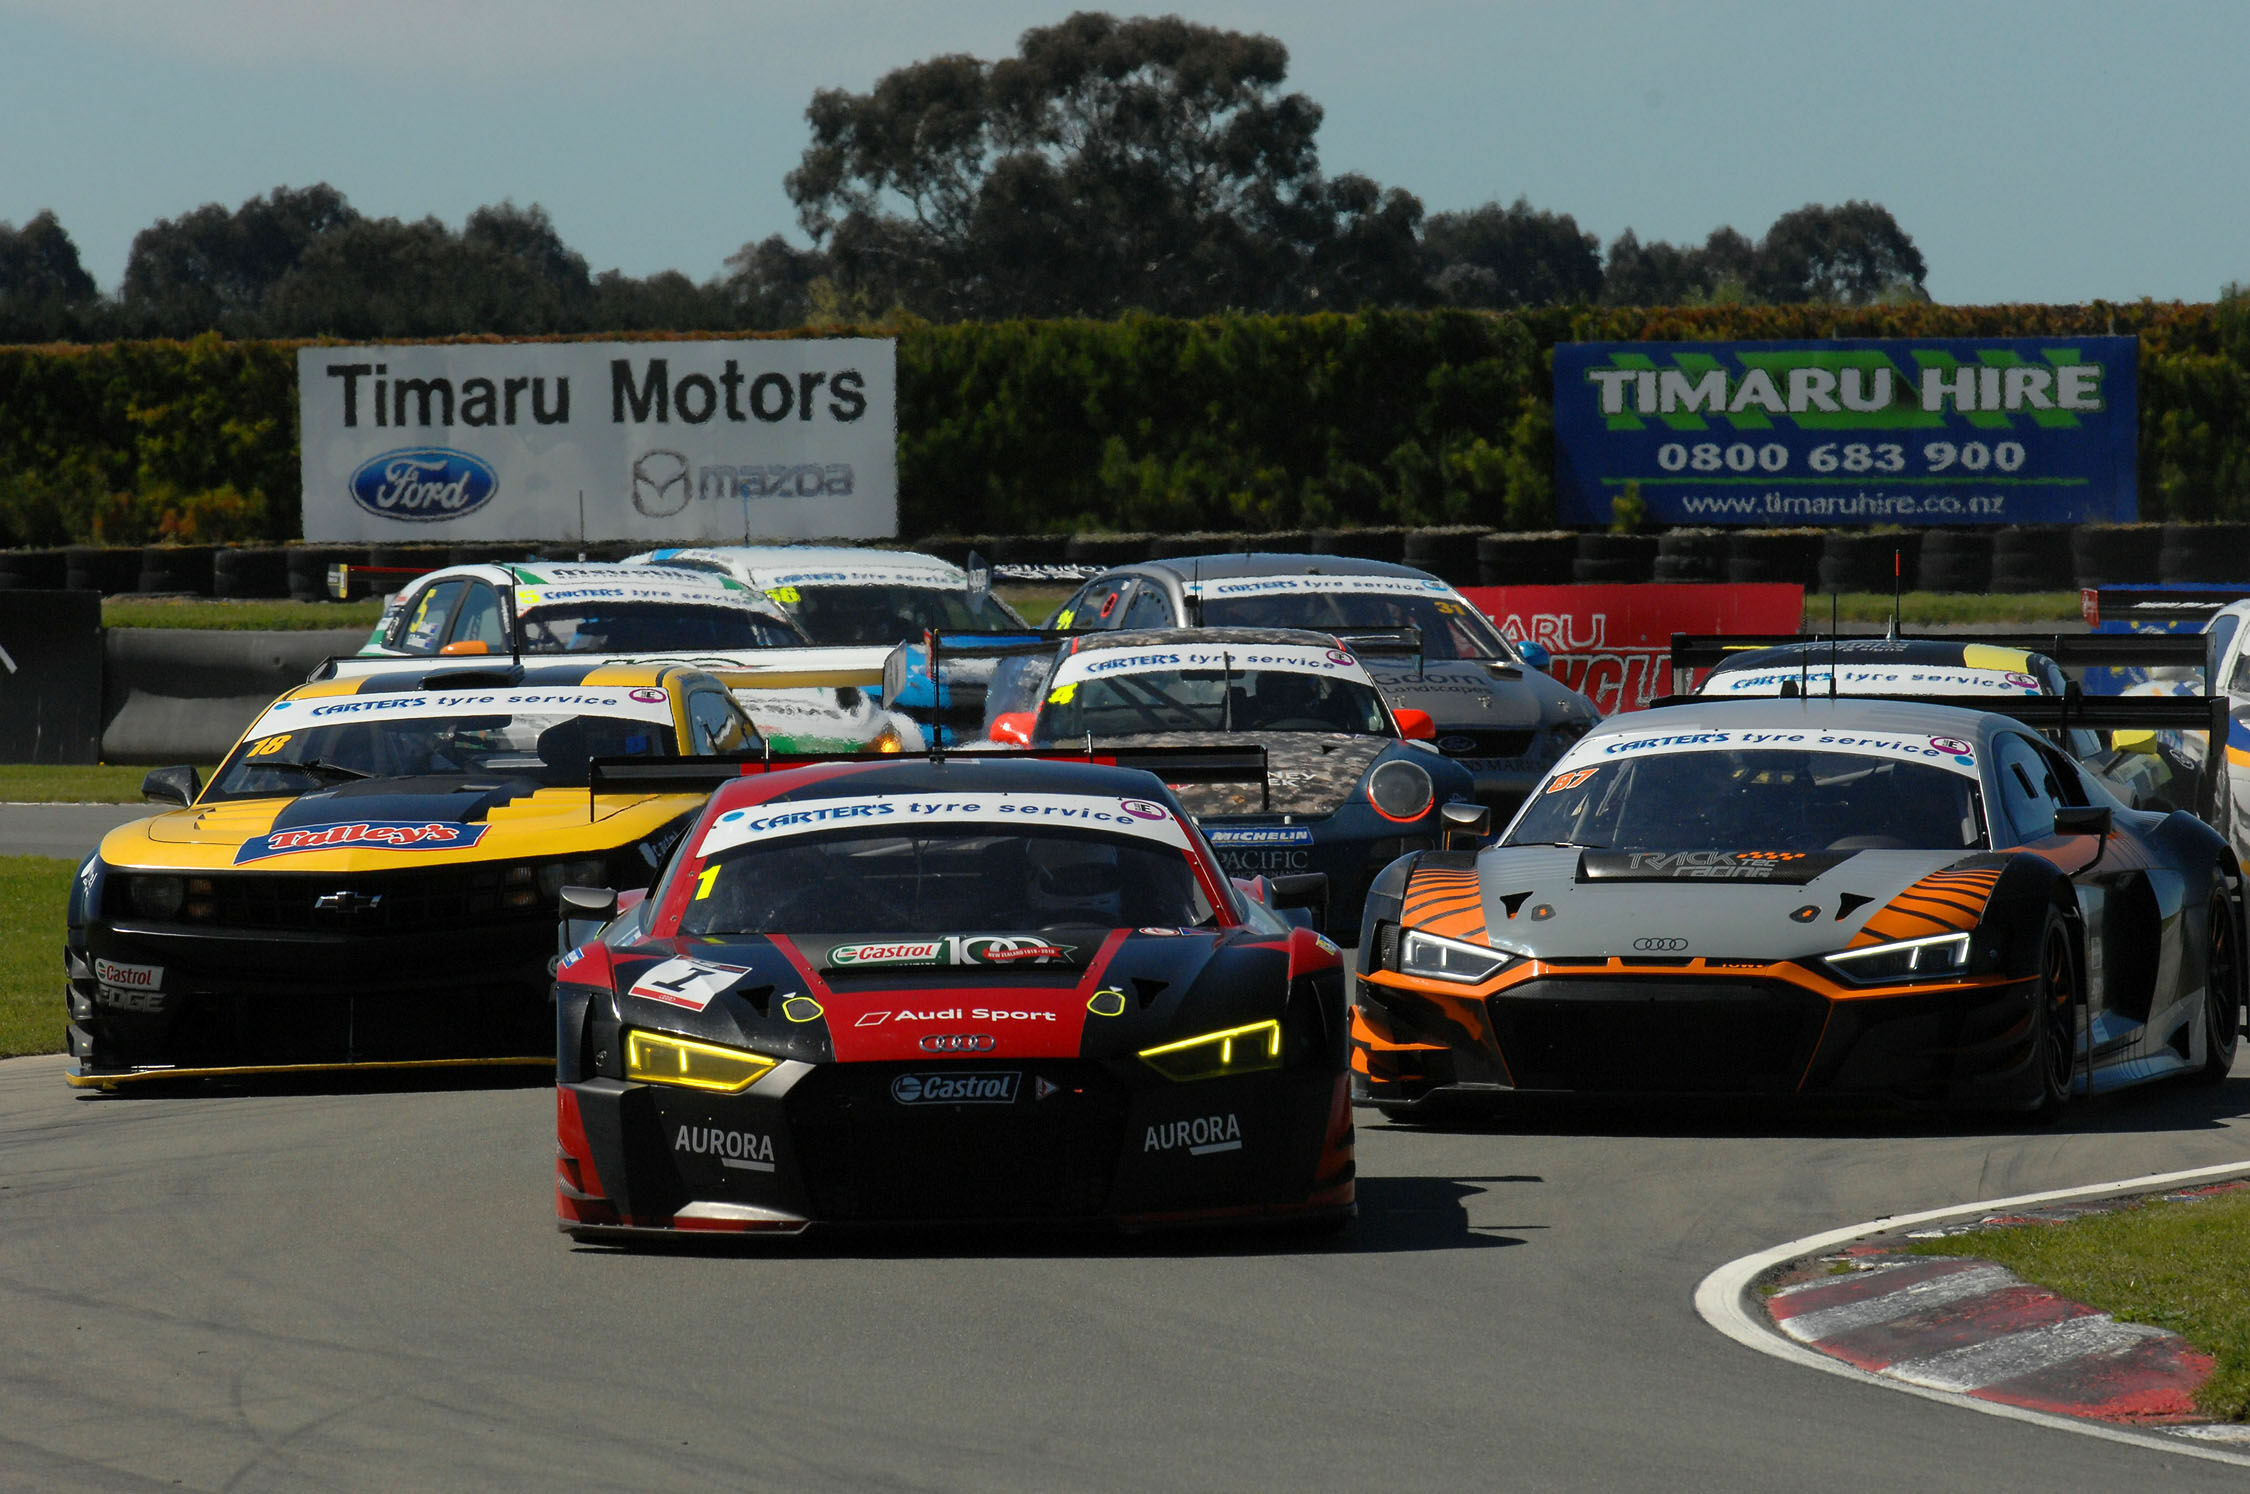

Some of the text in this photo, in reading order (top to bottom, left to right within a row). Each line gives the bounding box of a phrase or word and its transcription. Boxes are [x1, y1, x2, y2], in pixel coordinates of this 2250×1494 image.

[326, 358, 867, 427] Timaru Motors
[1588, 365, 2101, 414] TIMARU HIRE
[1658, 441, 2026, 472] 0800 683 900
[376, 458, 473, 508] Ford
[700, 463, 854, 499] mazda
[1682, 491, 2004, 515] www.timaruhire.co.nz
[519, 590, 540, 604] 5
[544, 588, 624, 600] CARTER'S
[1217, 579, 1425, 593] CARTER'S tyre service
[1433, 601, 1466, 615] 31
[1487, 614, 1606, 651] ARU
[1085, 652, 1335, 673] CARTER'S tyre service
[1846, 672, 1899, 682] tyre
[1912, 673, 2012, 690] service
[312, 694, 617, 716] CARTER'S tyre service
[246, 735, 292, 758] 18
[1605, 733, 1941, 757] CARTER'S tyre service
[1546, 767, 1599, 794] 87
[747, 800, 1135, 832] CARTER'S tyre service
[268, 824, 460, 850] Talley's
[1212, 831, 1308, 841] MICHELIN
[1628, 851, 1739, 871] TRACK
[694, 865, 722, 900] 1
[859, 944, 933, 959] Castrol
[106, 965, 152, 986] Castrol
[894, 1008, 1056, 1021] Audi Sport
[923, 1076, 1010, 1098] Castrol
[674, 1124, 775, 1161] AURORA
[1144, 1113, 1241, 1152] AURORA
